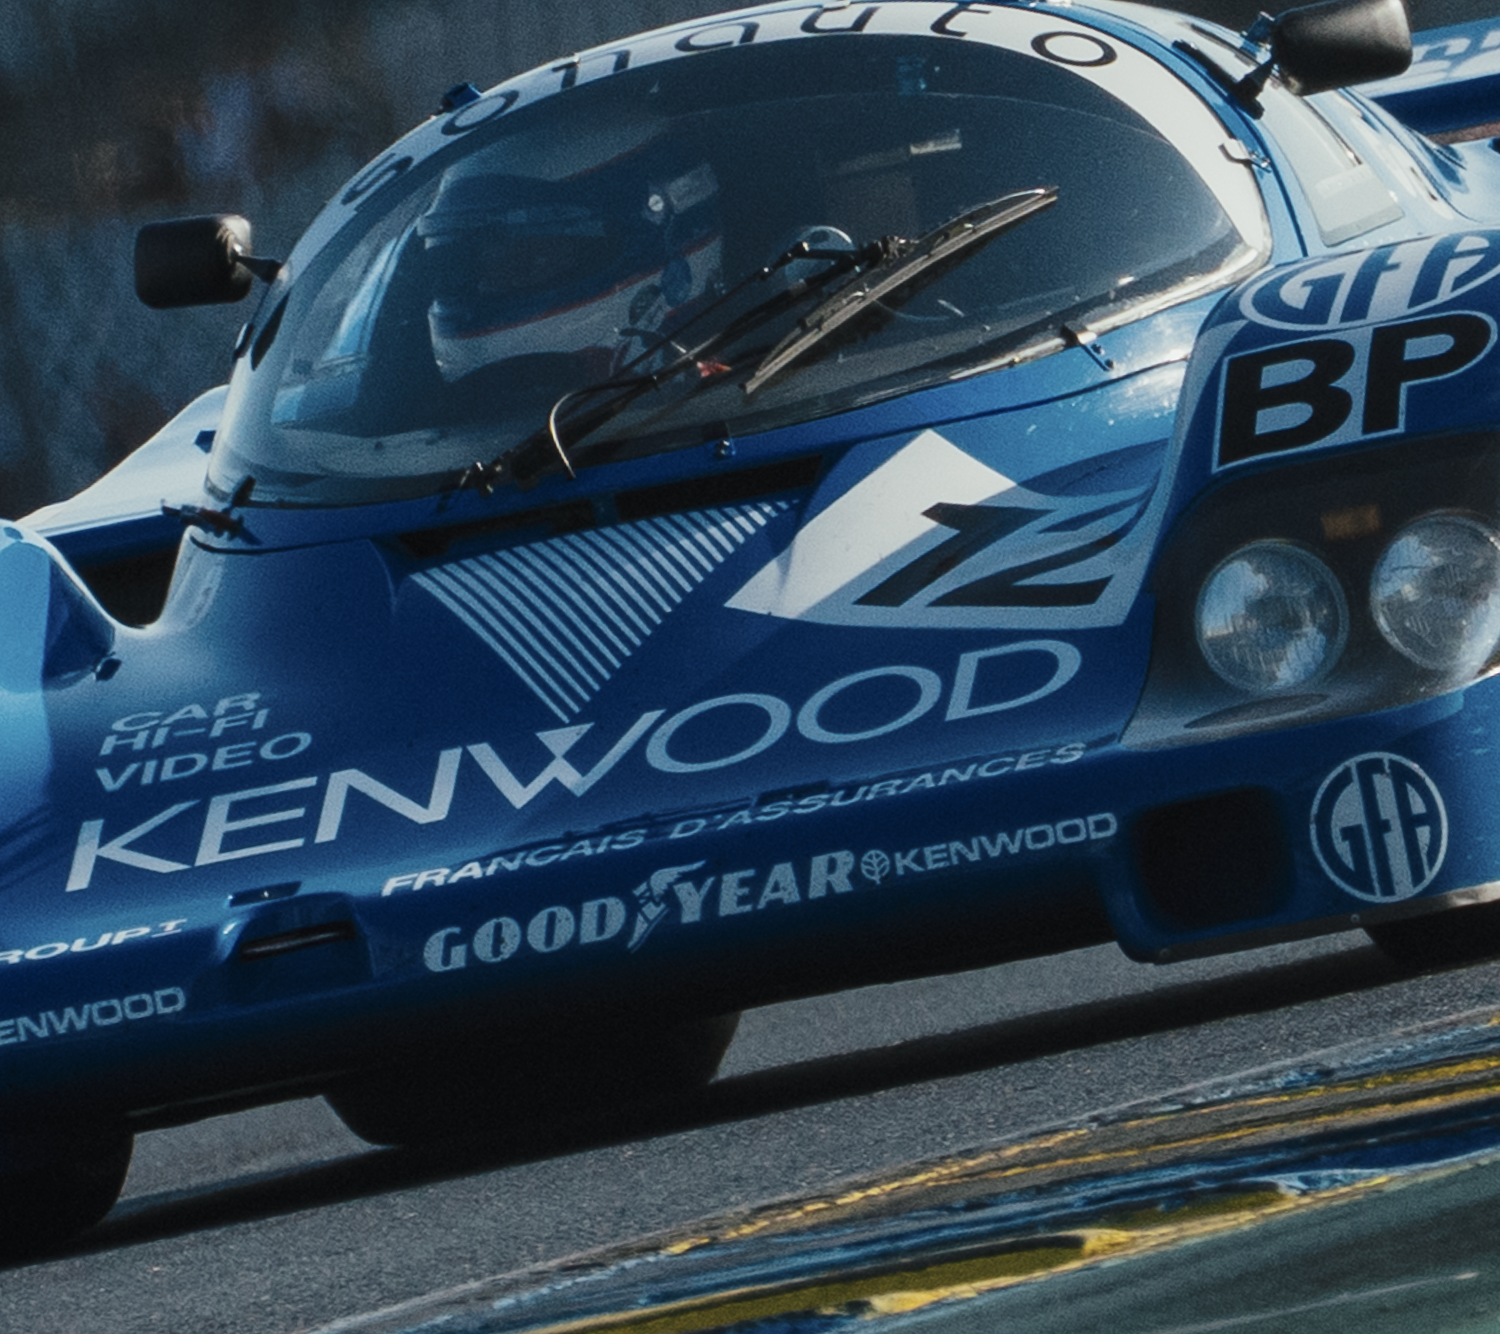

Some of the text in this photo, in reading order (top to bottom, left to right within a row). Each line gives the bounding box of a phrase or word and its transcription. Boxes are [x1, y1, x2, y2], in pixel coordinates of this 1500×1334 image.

[1212, 311, 1497, 473] BP
[65, 639, 1083, 893] KENWOOD
[95, 731, 312, 793] VIDEO
[100, 708, 269, 757] HI-FI
[111, 692, 262, 733] CAR
[381, 829, 648, 897] FRANCAIS
[669, 742, 1088, 841] D'ASSURANCES
[423, 812, 1118, 973] GOODYEAR KENWOOD
[1309, 751, 1448, 903] GFA
